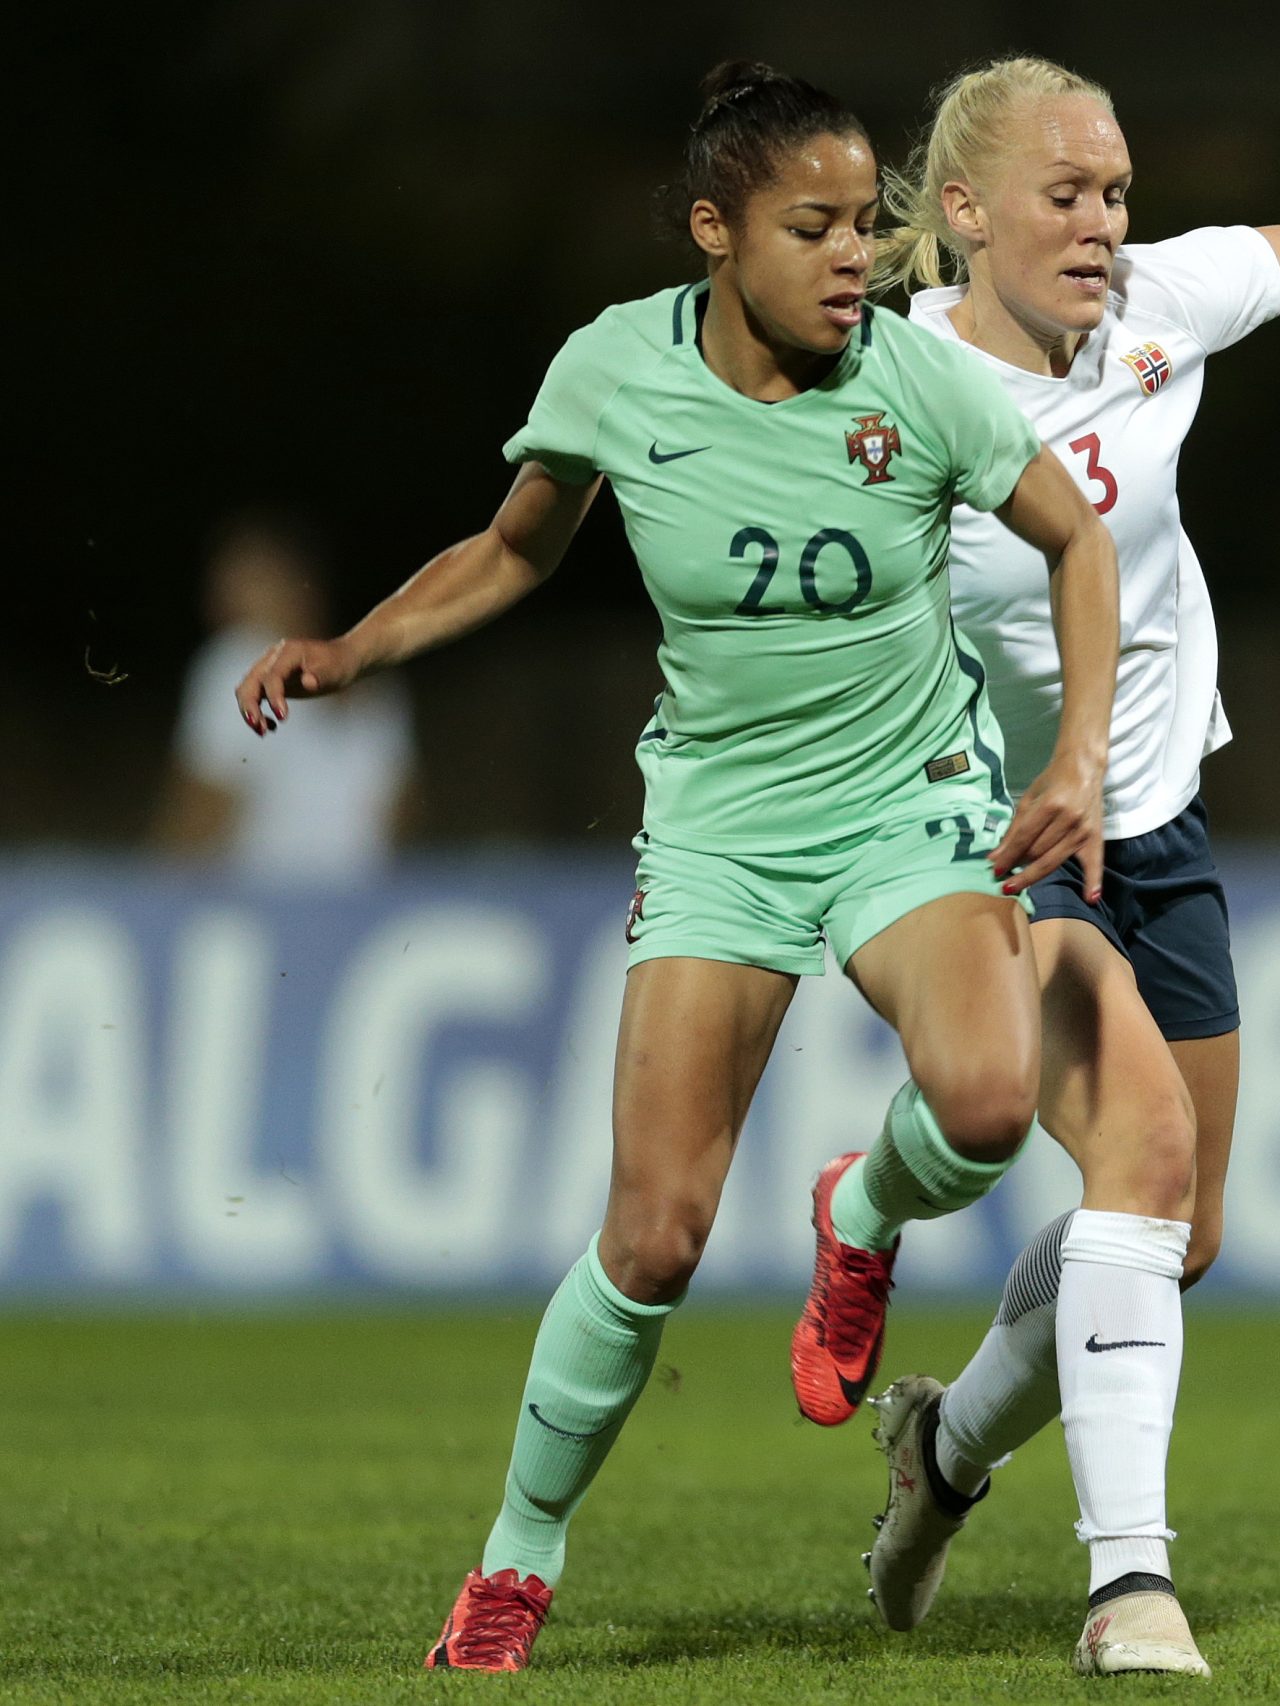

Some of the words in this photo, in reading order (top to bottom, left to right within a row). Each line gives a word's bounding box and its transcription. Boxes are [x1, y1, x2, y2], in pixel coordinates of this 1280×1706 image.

[1067, 431, 1118, 516] 3
[729, 526, 873, 616] 20
[925, 814, 1003, 863] 2
